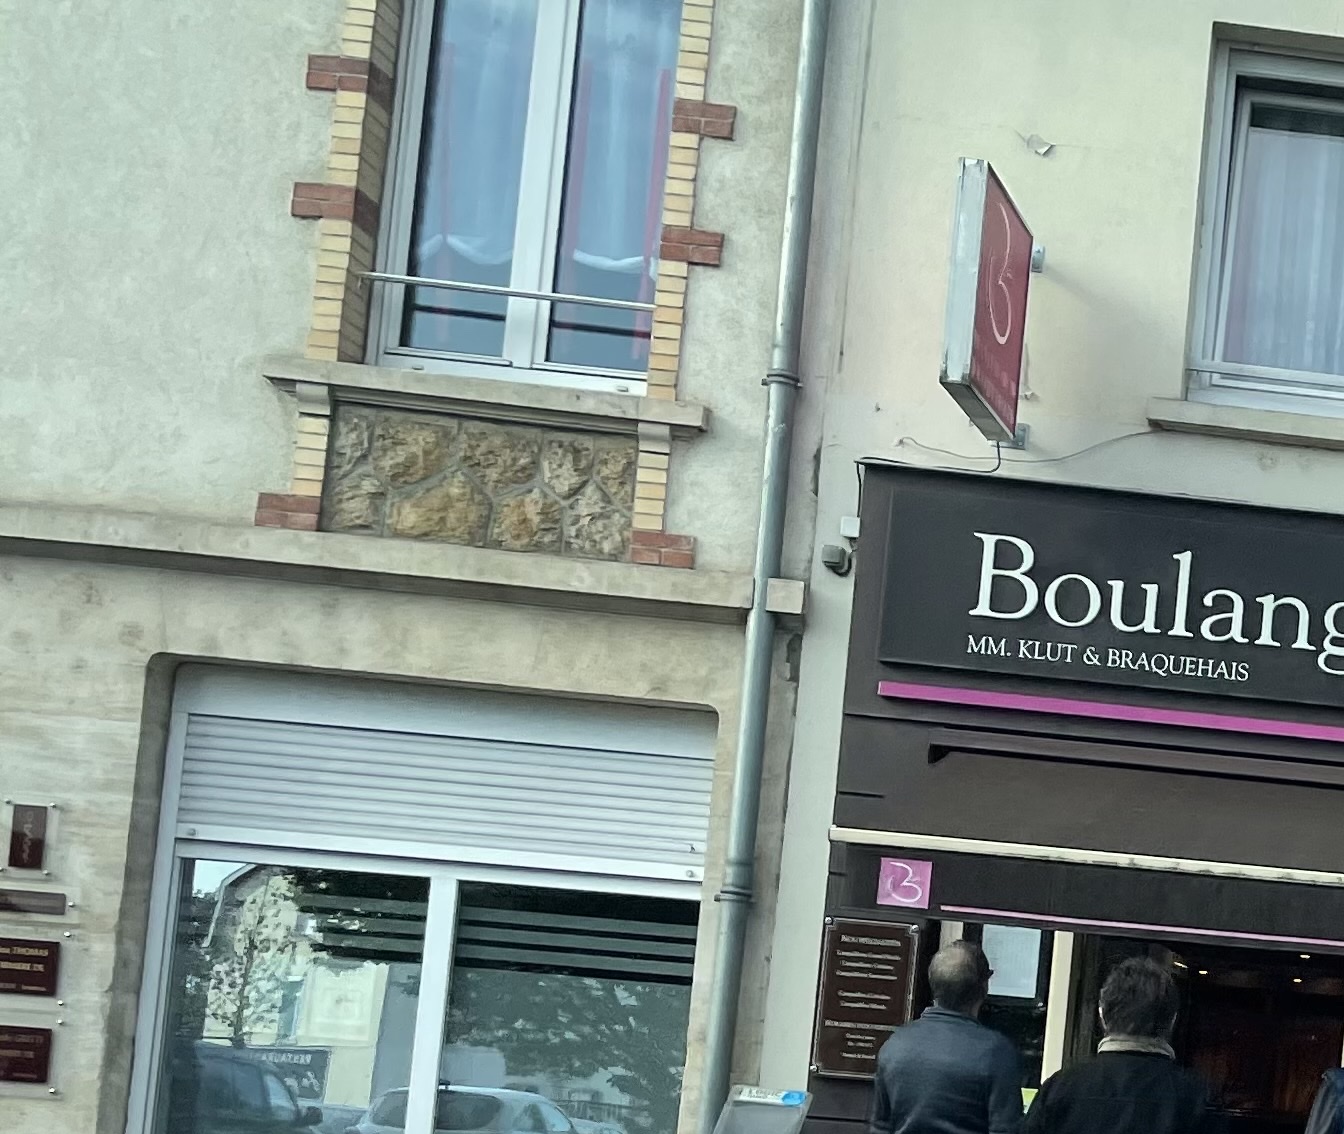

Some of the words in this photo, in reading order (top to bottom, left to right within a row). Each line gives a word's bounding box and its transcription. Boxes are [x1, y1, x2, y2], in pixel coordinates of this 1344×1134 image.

[966, 634, 1012, 658] MM.
[1018, 640, 1078, 664] KLUT
[1082, 646, 1102, 666] &
[1106, 648, 1250, 682] BRAQUEHAIS
